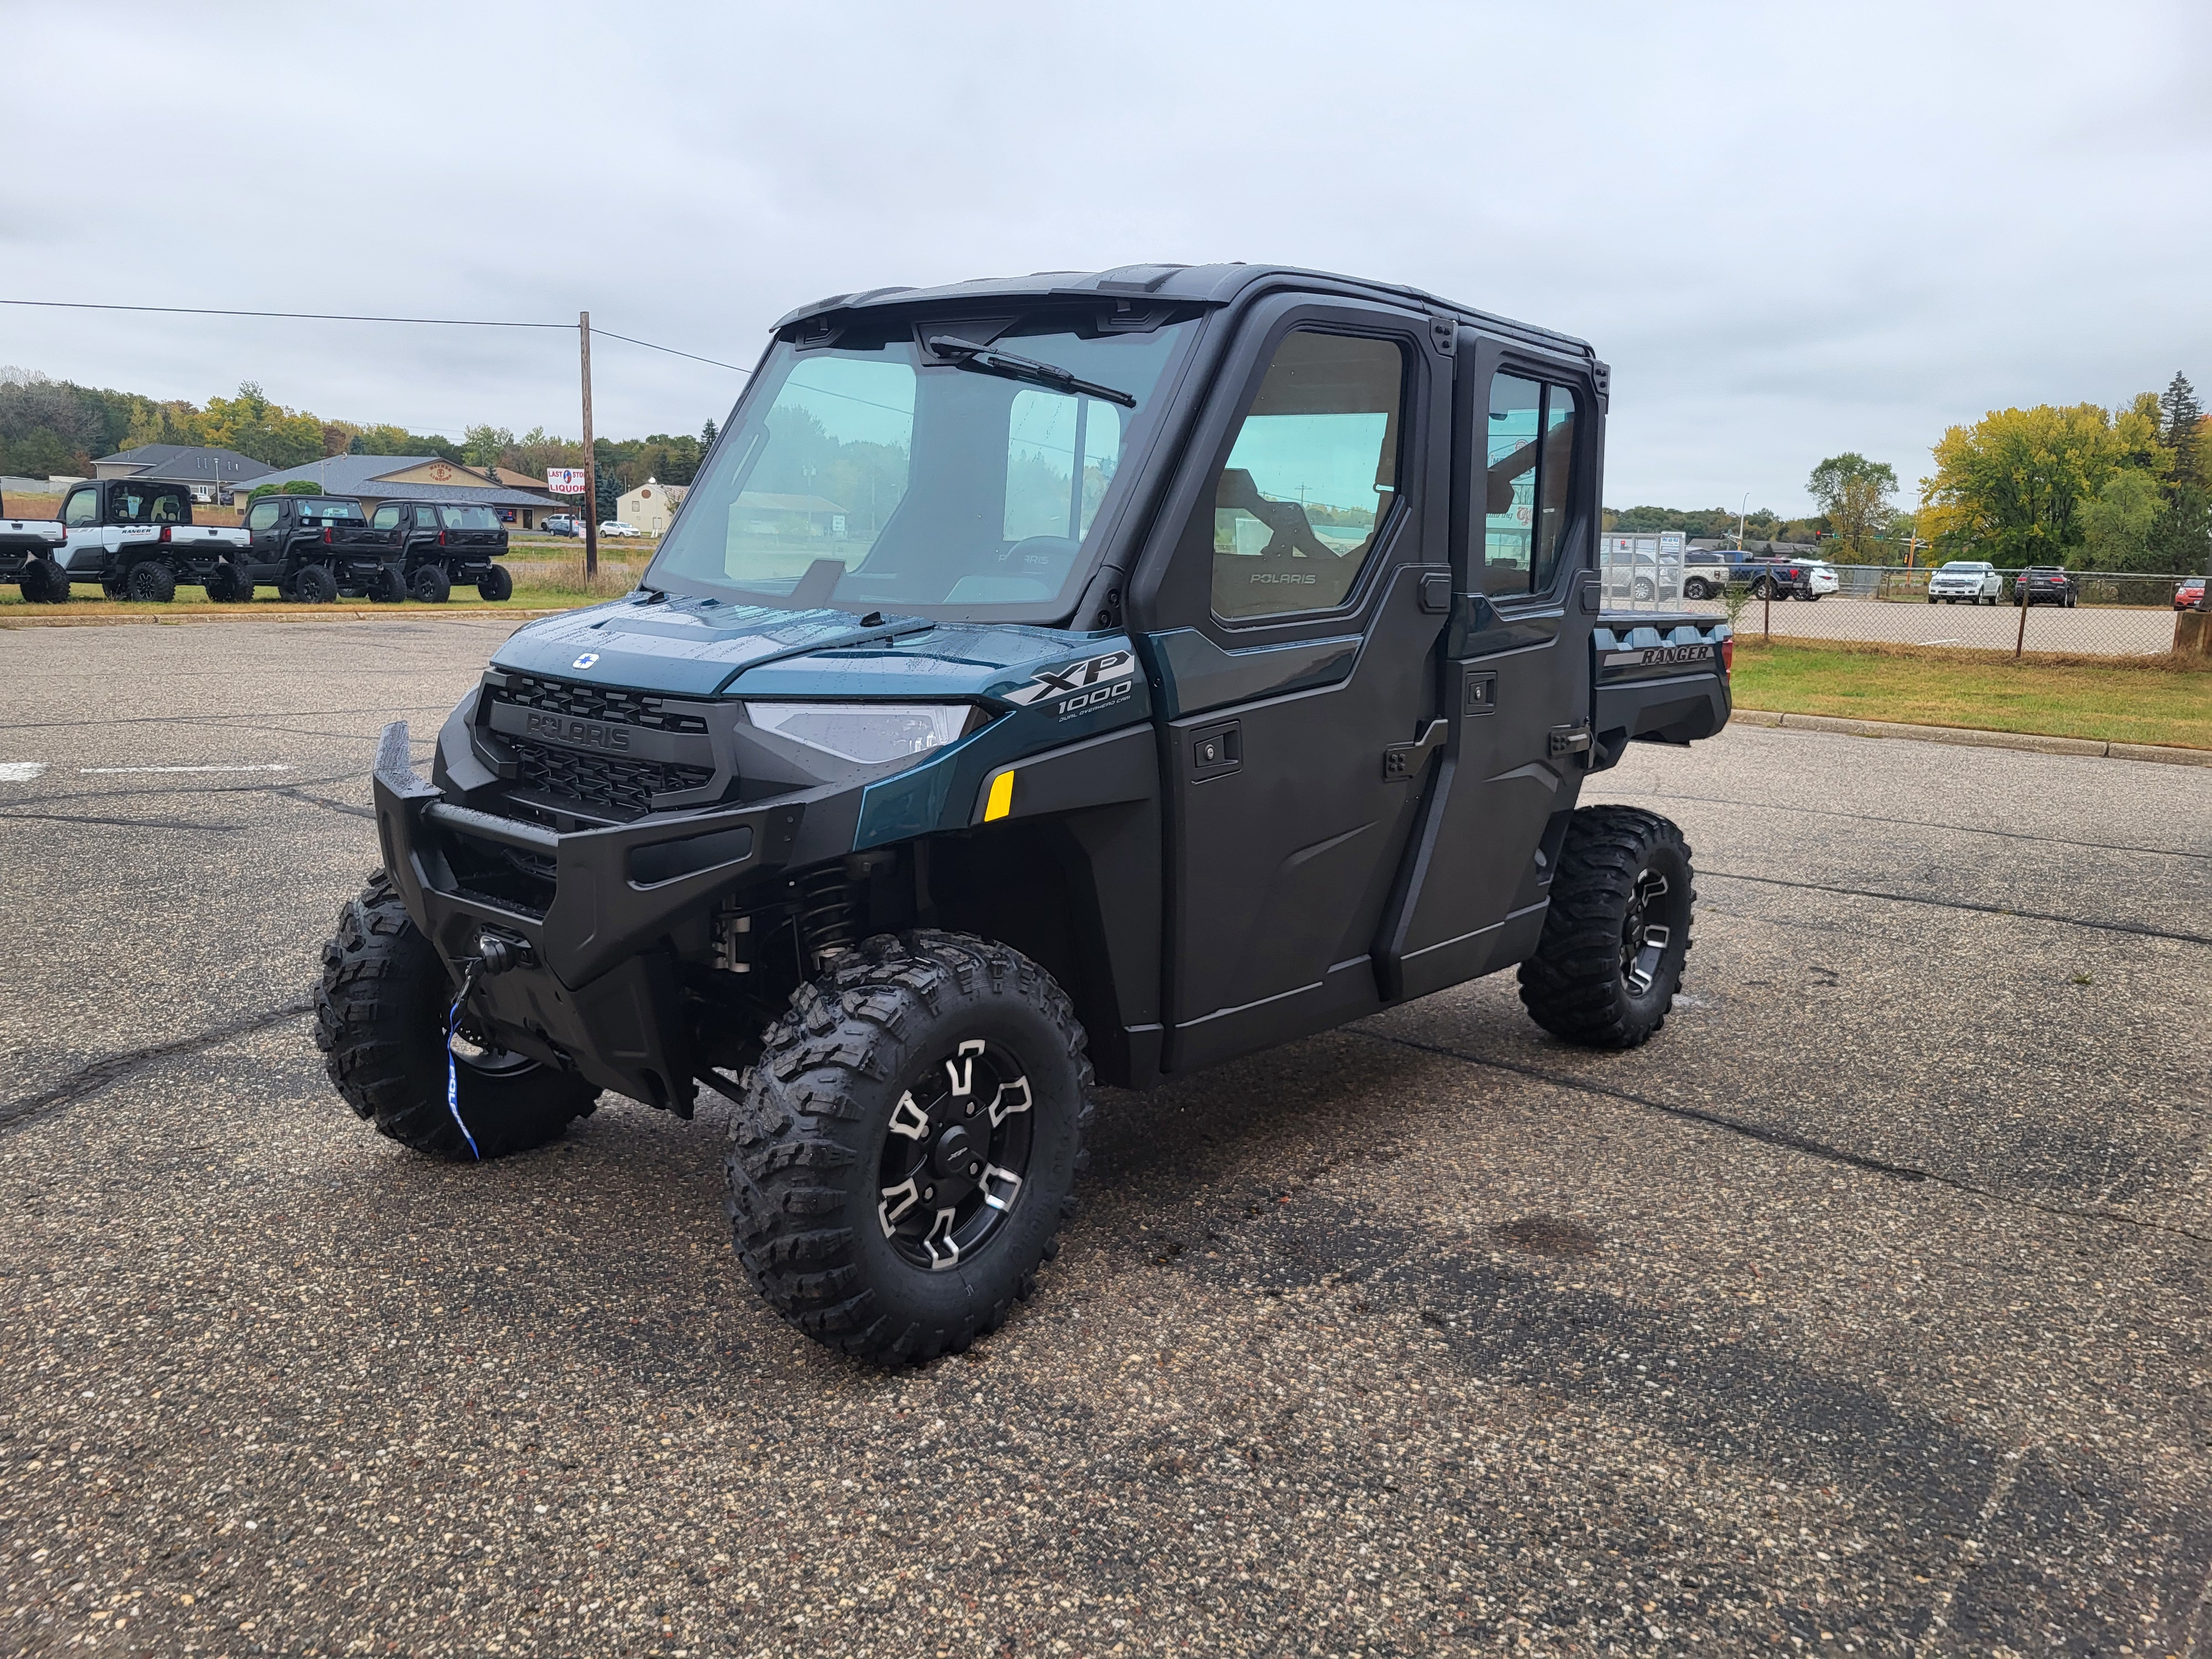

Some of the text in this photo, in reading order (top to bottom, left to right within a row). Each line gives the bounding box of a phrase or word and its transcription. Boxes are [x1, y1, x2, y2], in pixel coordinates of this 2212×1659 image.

[998, 554, 1050, 565] PARIS
[1250, 573, 1316, 584] POLARIS
[1641, 646, 1708, 665] RANGER
[1026, 651, 1130, 704] XP
[1058, 681, 1131, 714] 1000
[1058, 695, 1131, 722] DUAL OVERHEAD CAM
[527, 713, 630, 752] POLARIS
[947, 1147, 968, 1161] XP
